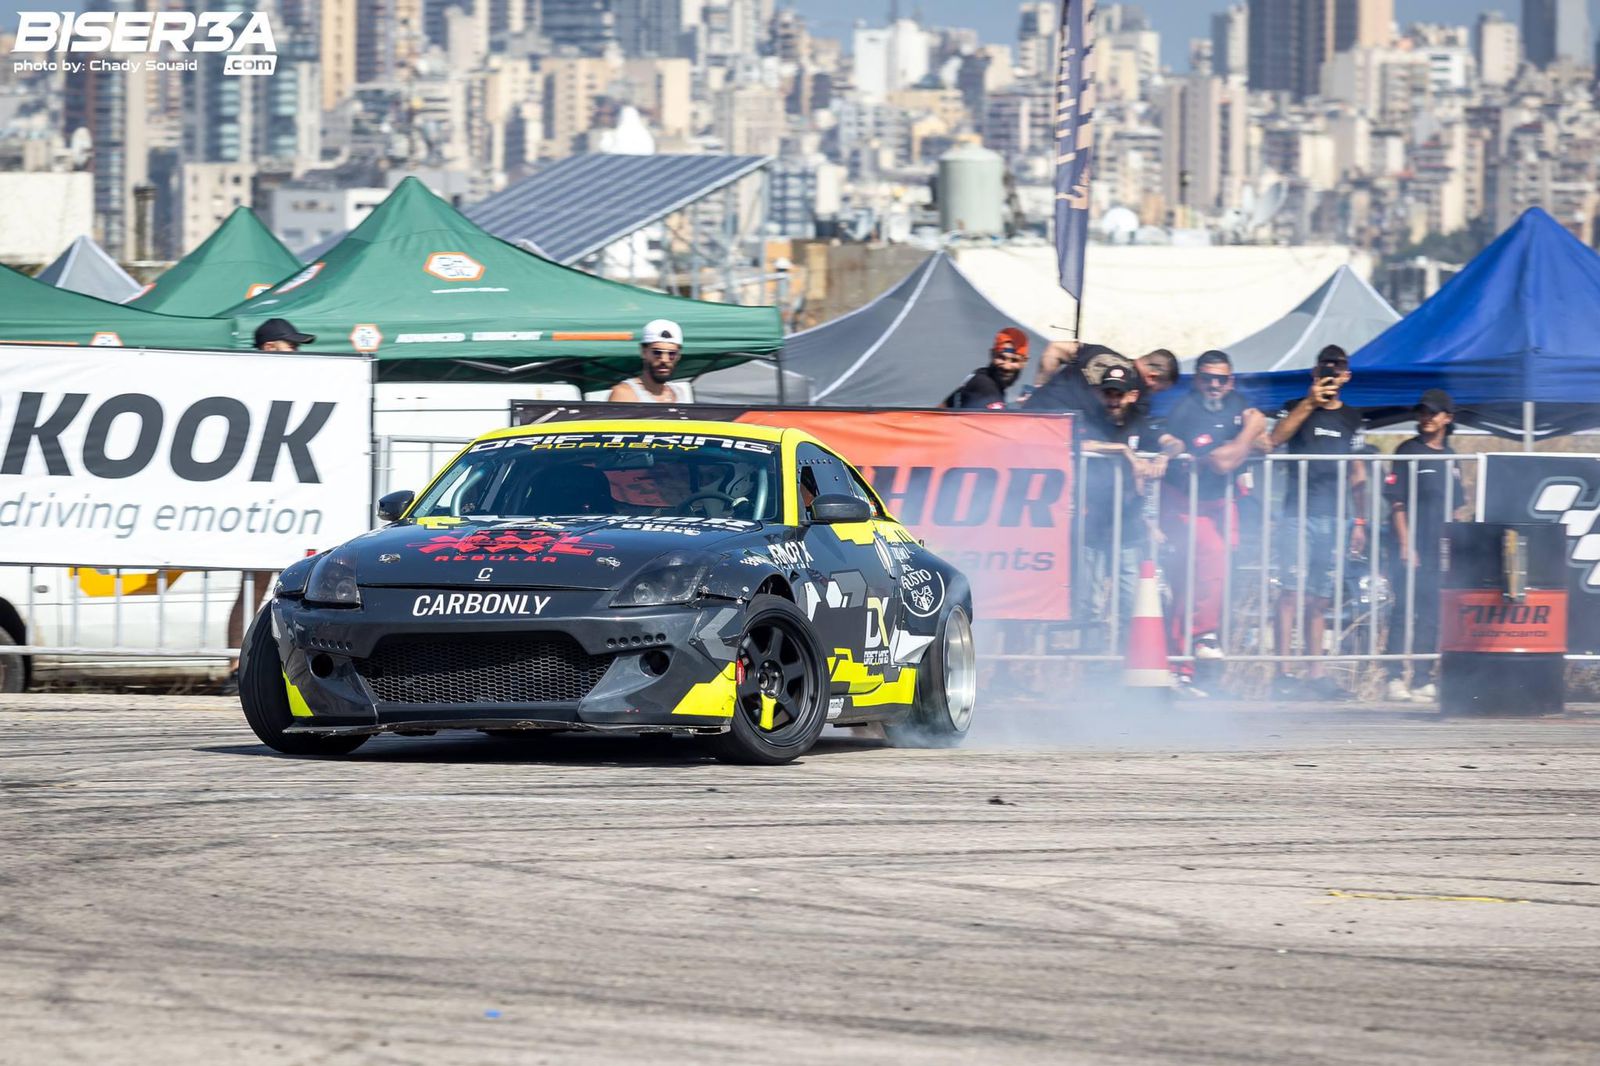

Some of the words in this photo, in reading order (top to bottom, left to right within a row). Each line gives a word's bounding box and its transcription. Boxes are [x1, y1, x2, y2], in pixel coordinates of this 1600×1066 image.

[0, 391, 338, 483] KOOK
[531, 442, 699, 451] ACADEMY
[857, 466, 1066, 527] HOR
[0, 492, 140, 538] driving
[154, 499, 323, 534] emotion
[433, 555, 557, 563] REGULAR
[412, 593, 551, 616] CARBONLY
